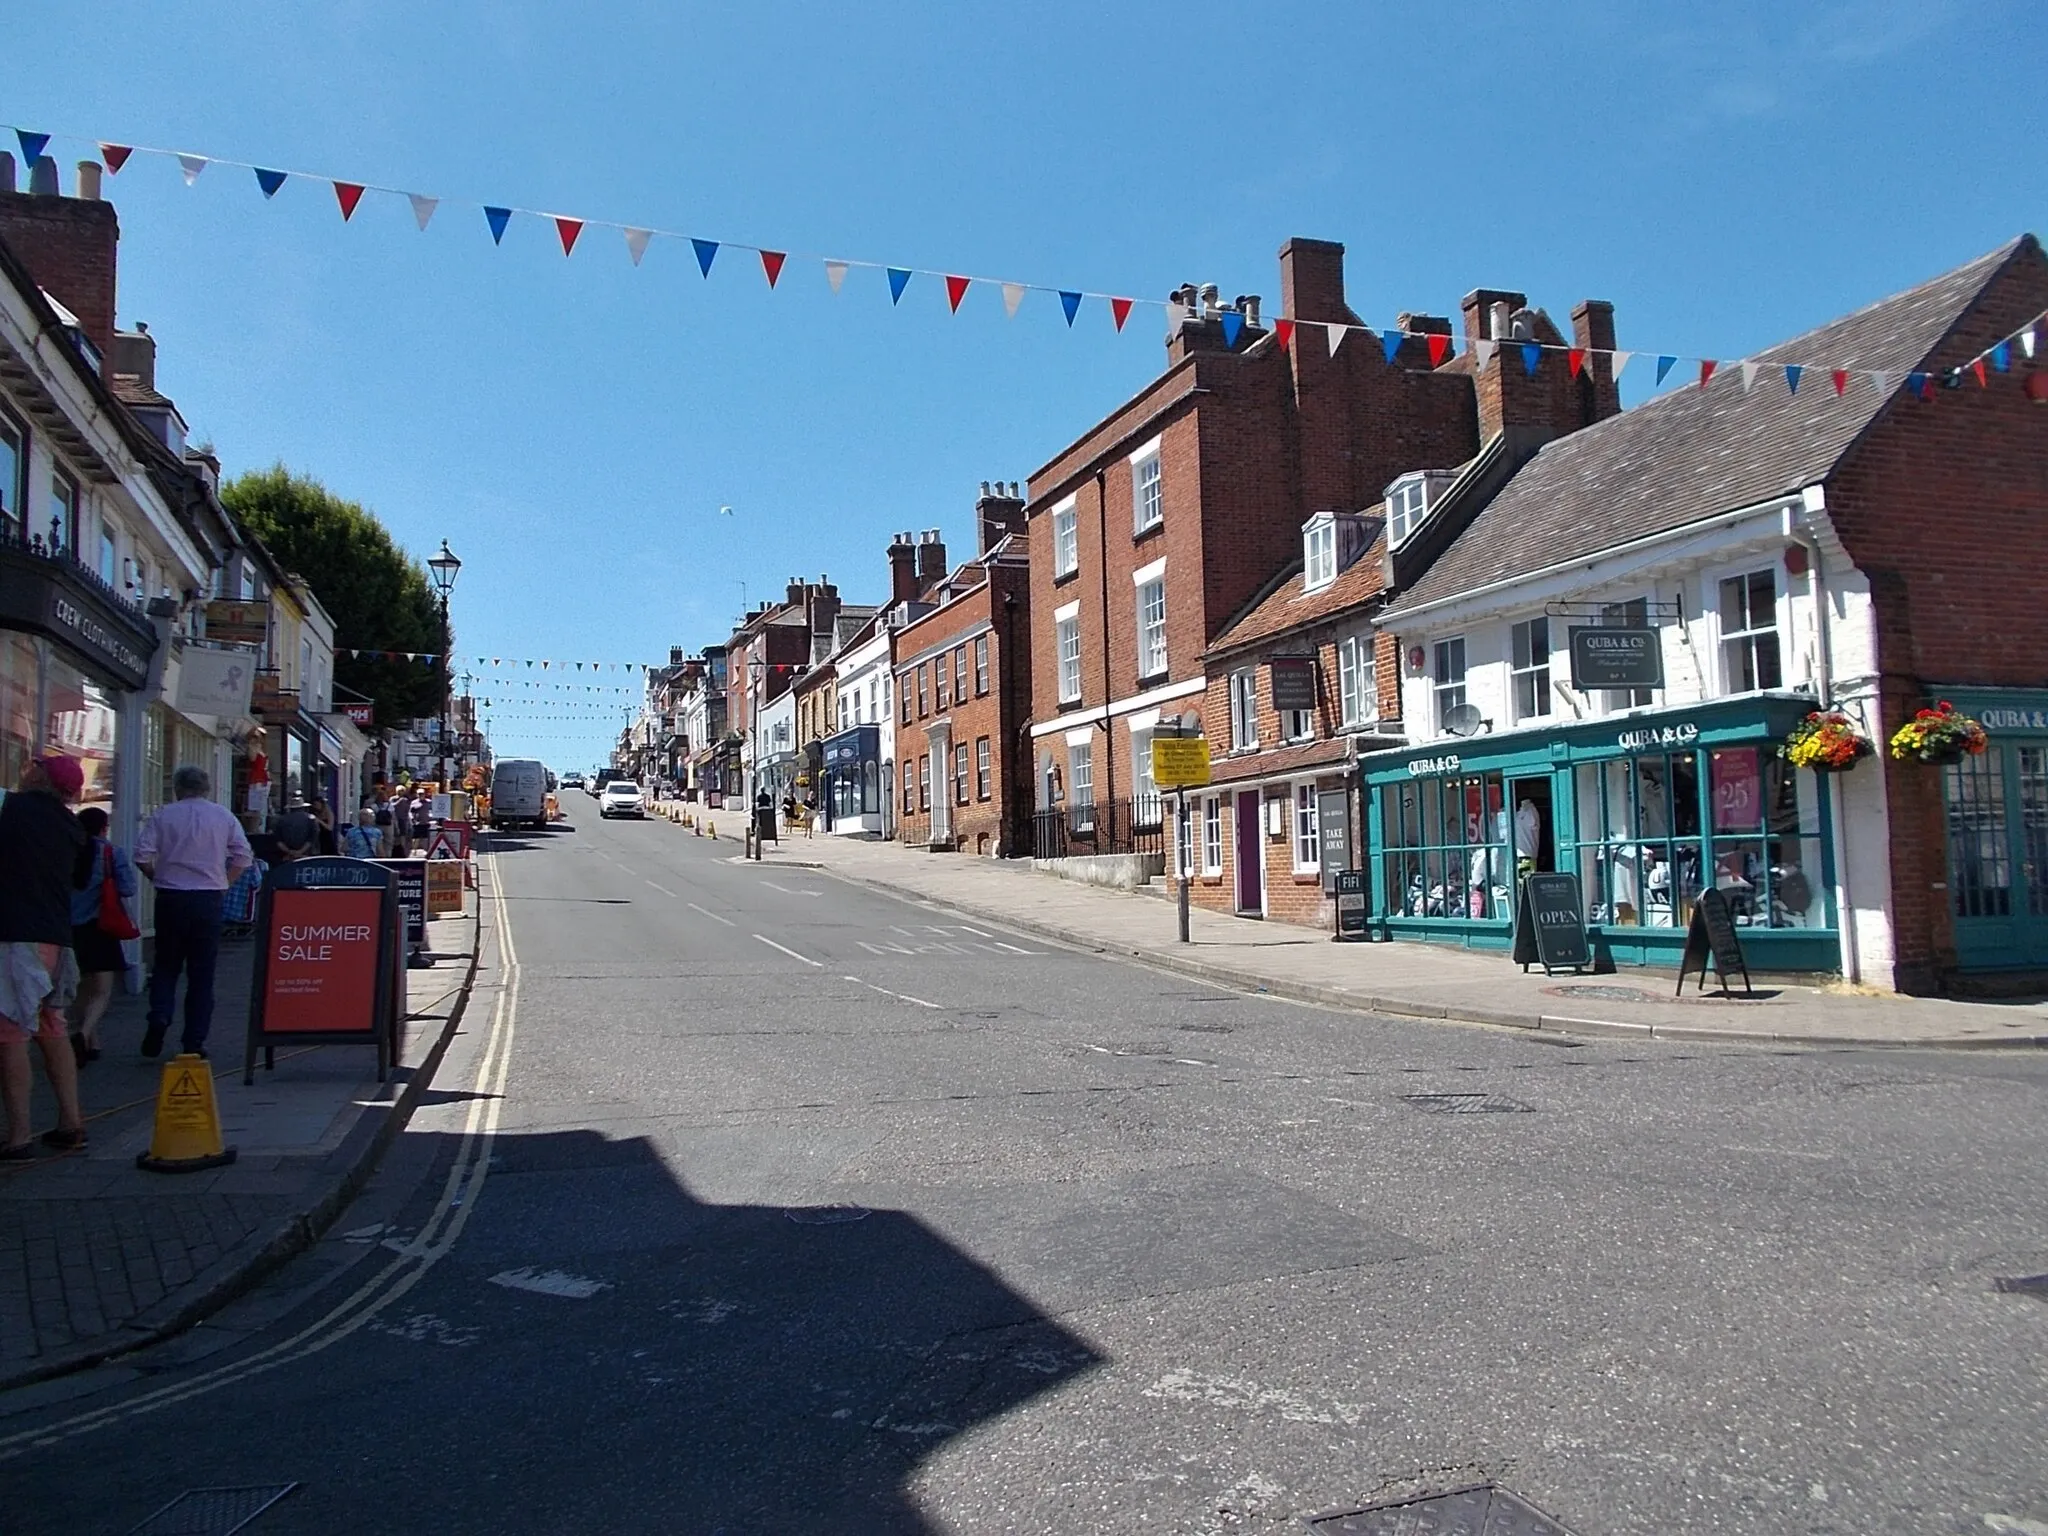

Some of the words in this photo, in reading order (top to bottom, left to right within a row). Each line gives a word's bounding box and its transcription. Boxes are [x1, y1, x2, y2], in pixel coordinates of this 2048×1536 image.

[57, 599, 82, 630] CREW
[83, 618, 119, 657] CLOTHING
[1587, 637, 1618, 649] QUBA
[1620, 637, 1629, 648] &
[1982, 710, 2031, 729] QUBA
[2032, 711, 2047, 728] &
[1618, 728, 1660, 749] QUBA
[1662, 726, 1676, 743] &
[1408, 758, 1437, 776] QUBA
[1437, 757, 1445, 771] &
[1325, 828, 1343, 839] TAKE
[1325, 840, 1345, 850] AWAY
[1343, 876, 1360, 888] FIFI
[430, 891, 458, 901] OPEN
[1540, 910, 1578, 925] OPEN
[280, 926, 371, 941] SUMMER
[278, 945, 333, 961] SALE
